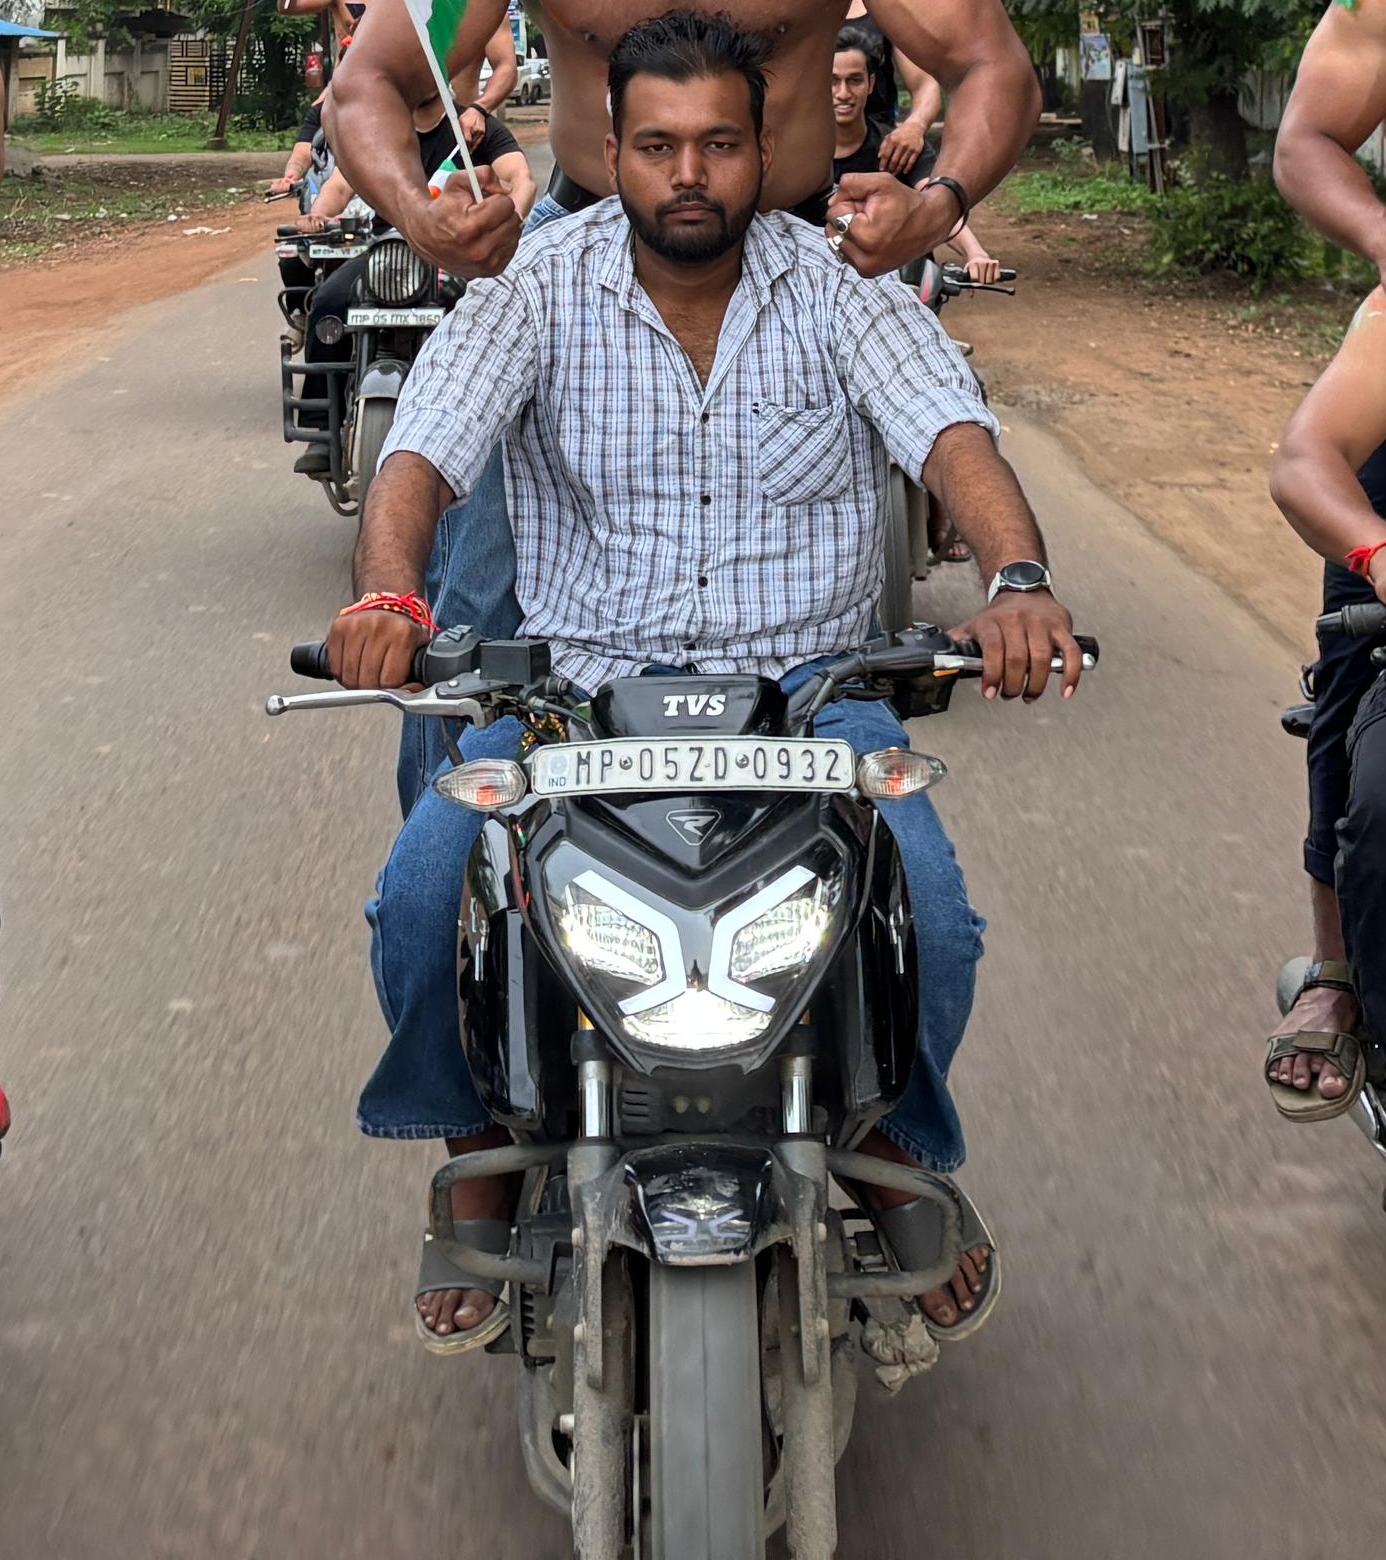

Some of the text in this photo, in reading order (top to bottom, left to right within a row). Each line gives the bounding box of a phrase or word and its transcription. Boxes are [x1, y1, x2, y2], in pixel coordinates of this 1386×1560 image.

[662, 694, 726, 718] TVS
[575, 748, 613, 786] MP
[752, 746, 840, 782] 0932
[548, 776, 566, 788] IND
